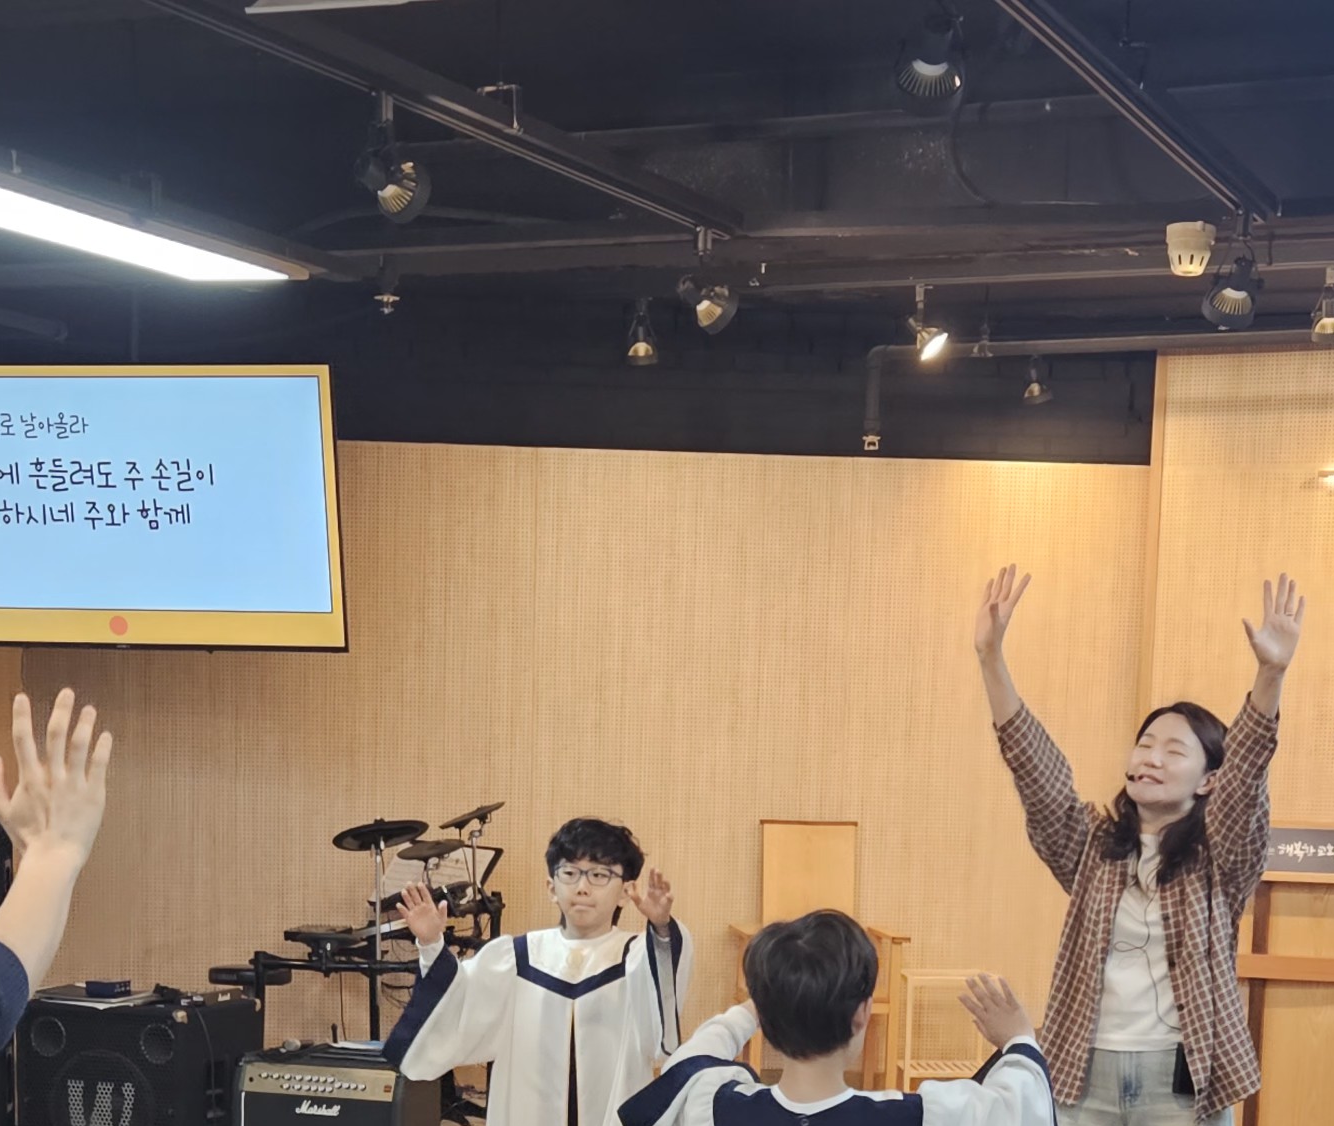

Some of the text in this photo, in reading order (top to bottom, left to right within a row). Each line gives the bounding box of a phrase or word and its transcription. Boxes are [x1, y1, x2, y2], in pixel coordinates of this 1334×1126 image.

[19, 411, 90, 440] 날아올라
[27, 456, 118, 493] 흔들려도
[123, 461, 145, 491] 주
[150, 458, 215, 492] 손길이
[83, 500, 131, 531] 주와
[136, 497, 192, 531] 함께
[295, 1100, 341, 1117] Marshall
